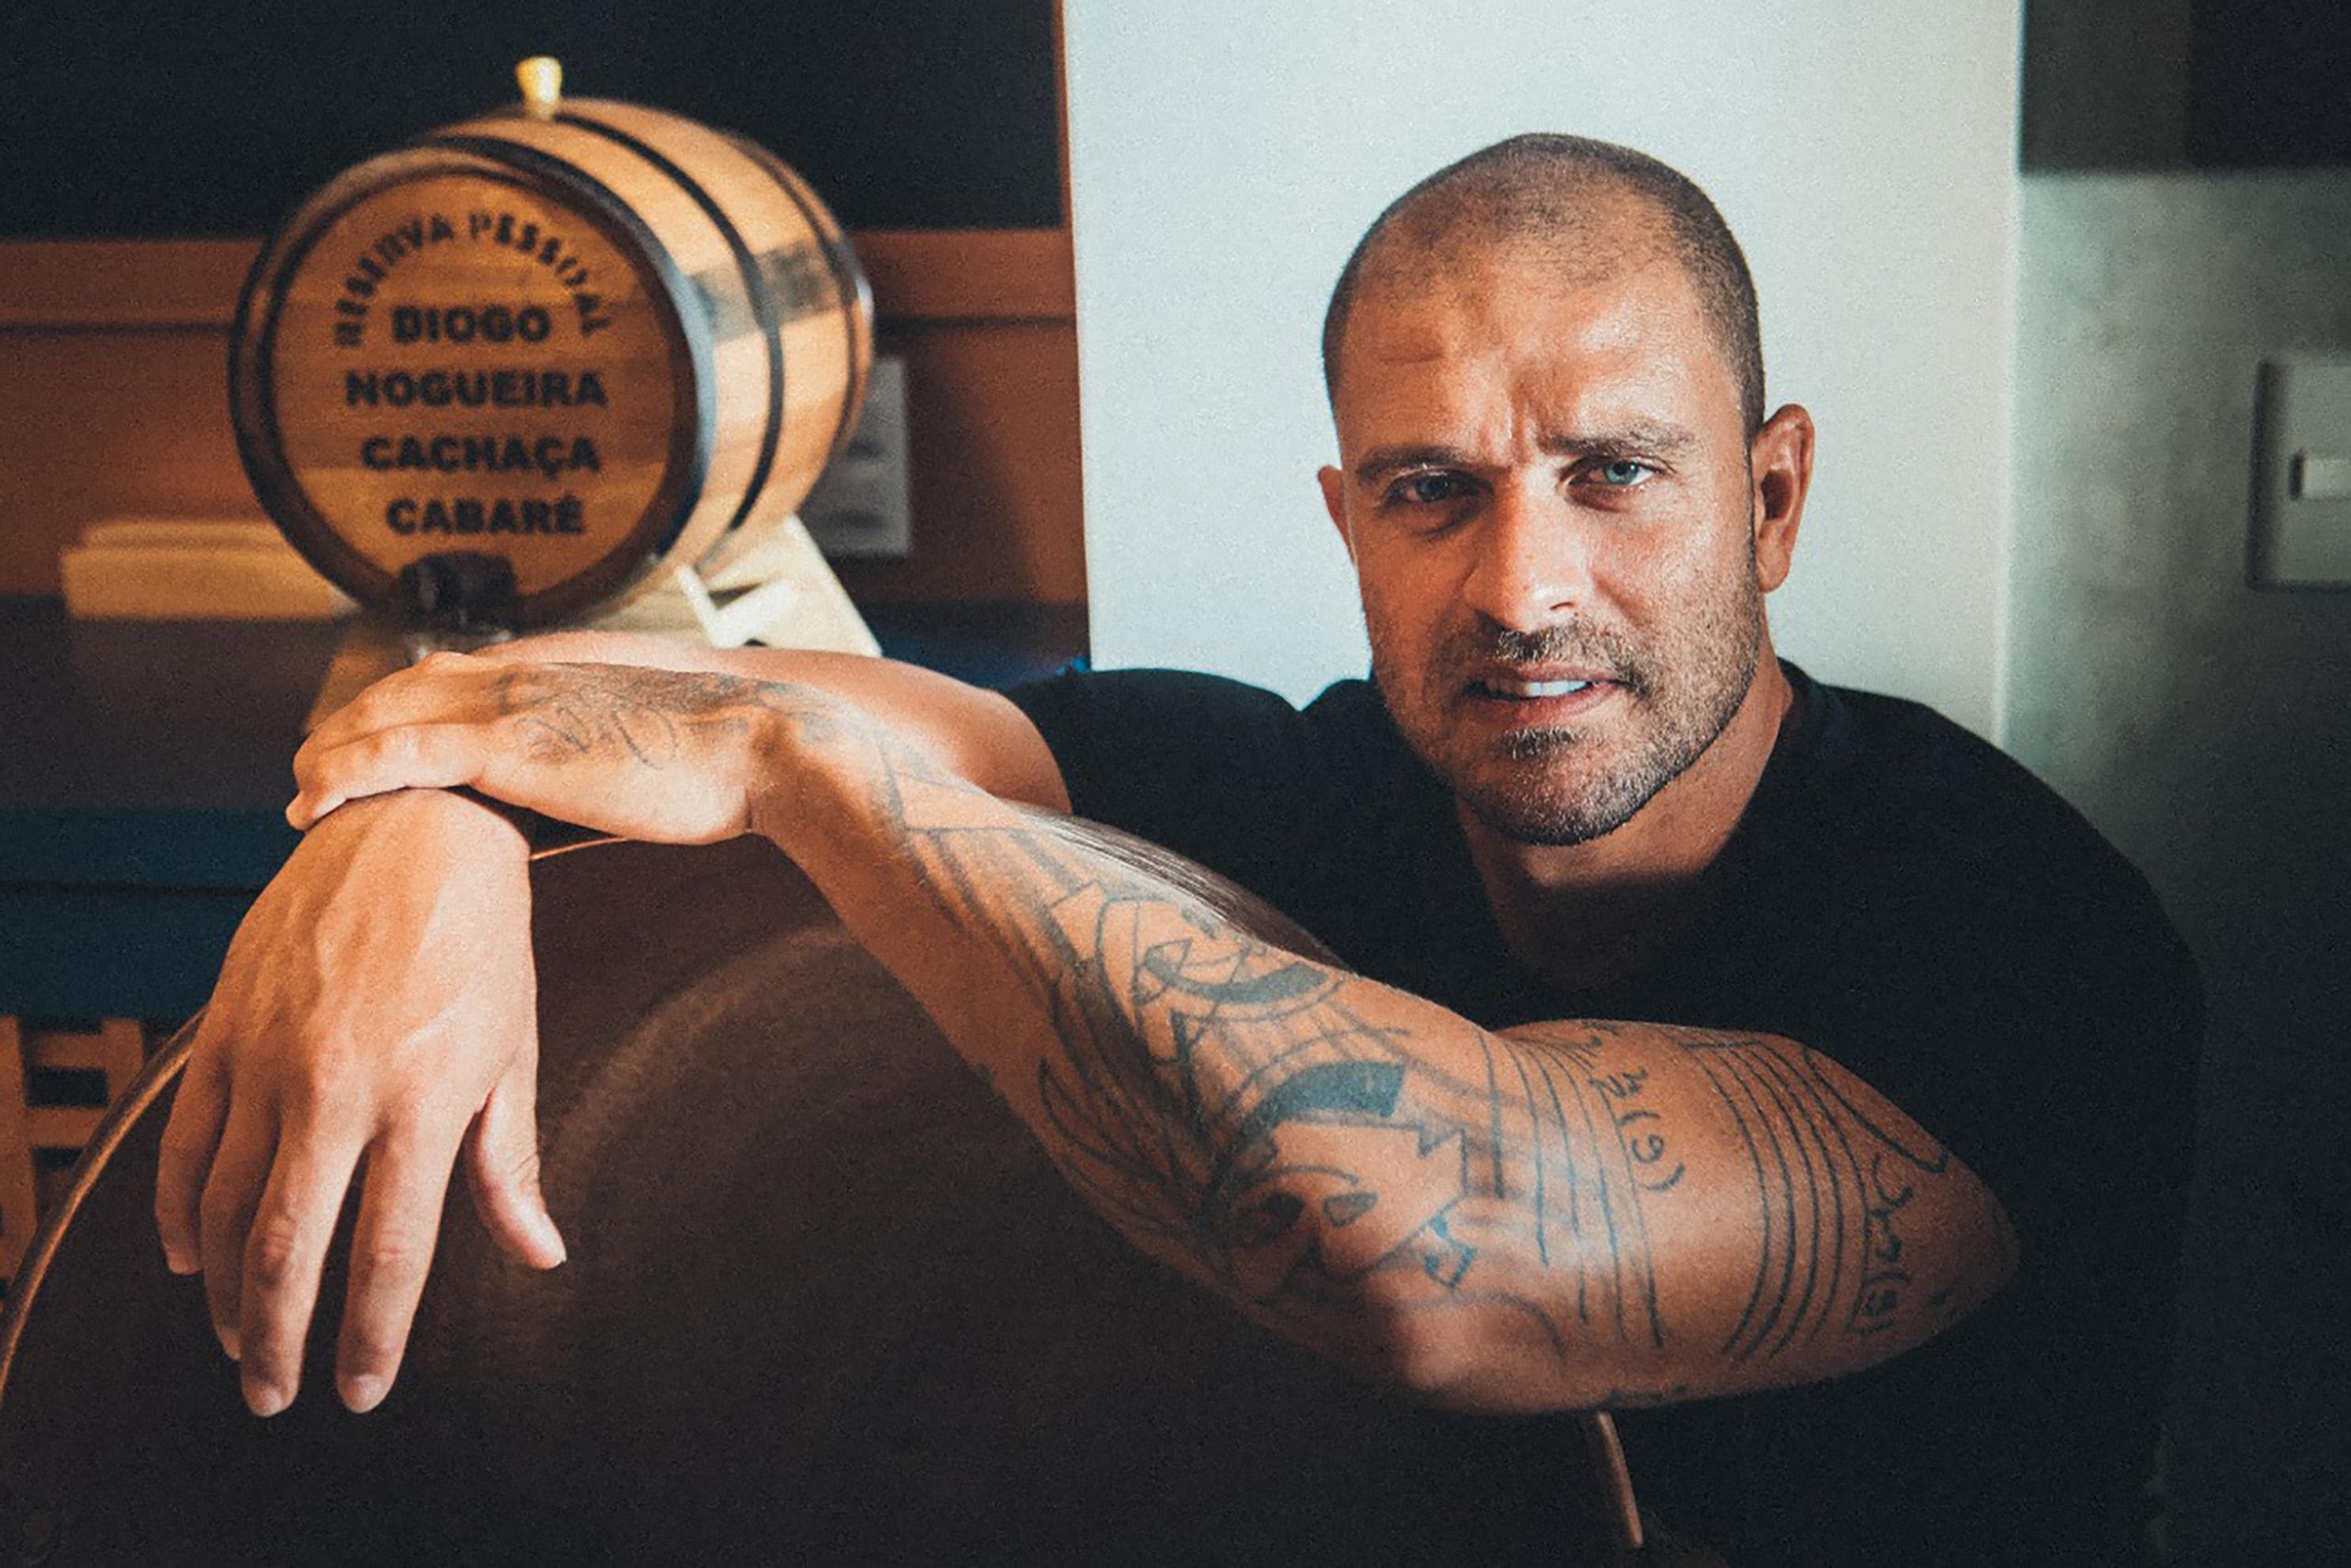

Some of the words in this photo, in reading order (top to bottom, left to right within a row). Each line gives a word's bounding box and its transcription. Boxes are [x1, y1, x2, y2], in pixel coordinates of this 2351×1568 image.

[393, 305, 552, 343] DIOGO
[345, 372, 608, 407] NOGUEIRA
[362, 437, 601, 480] CACHAÇA
[388, 493, 585, 536] CABARÉ
